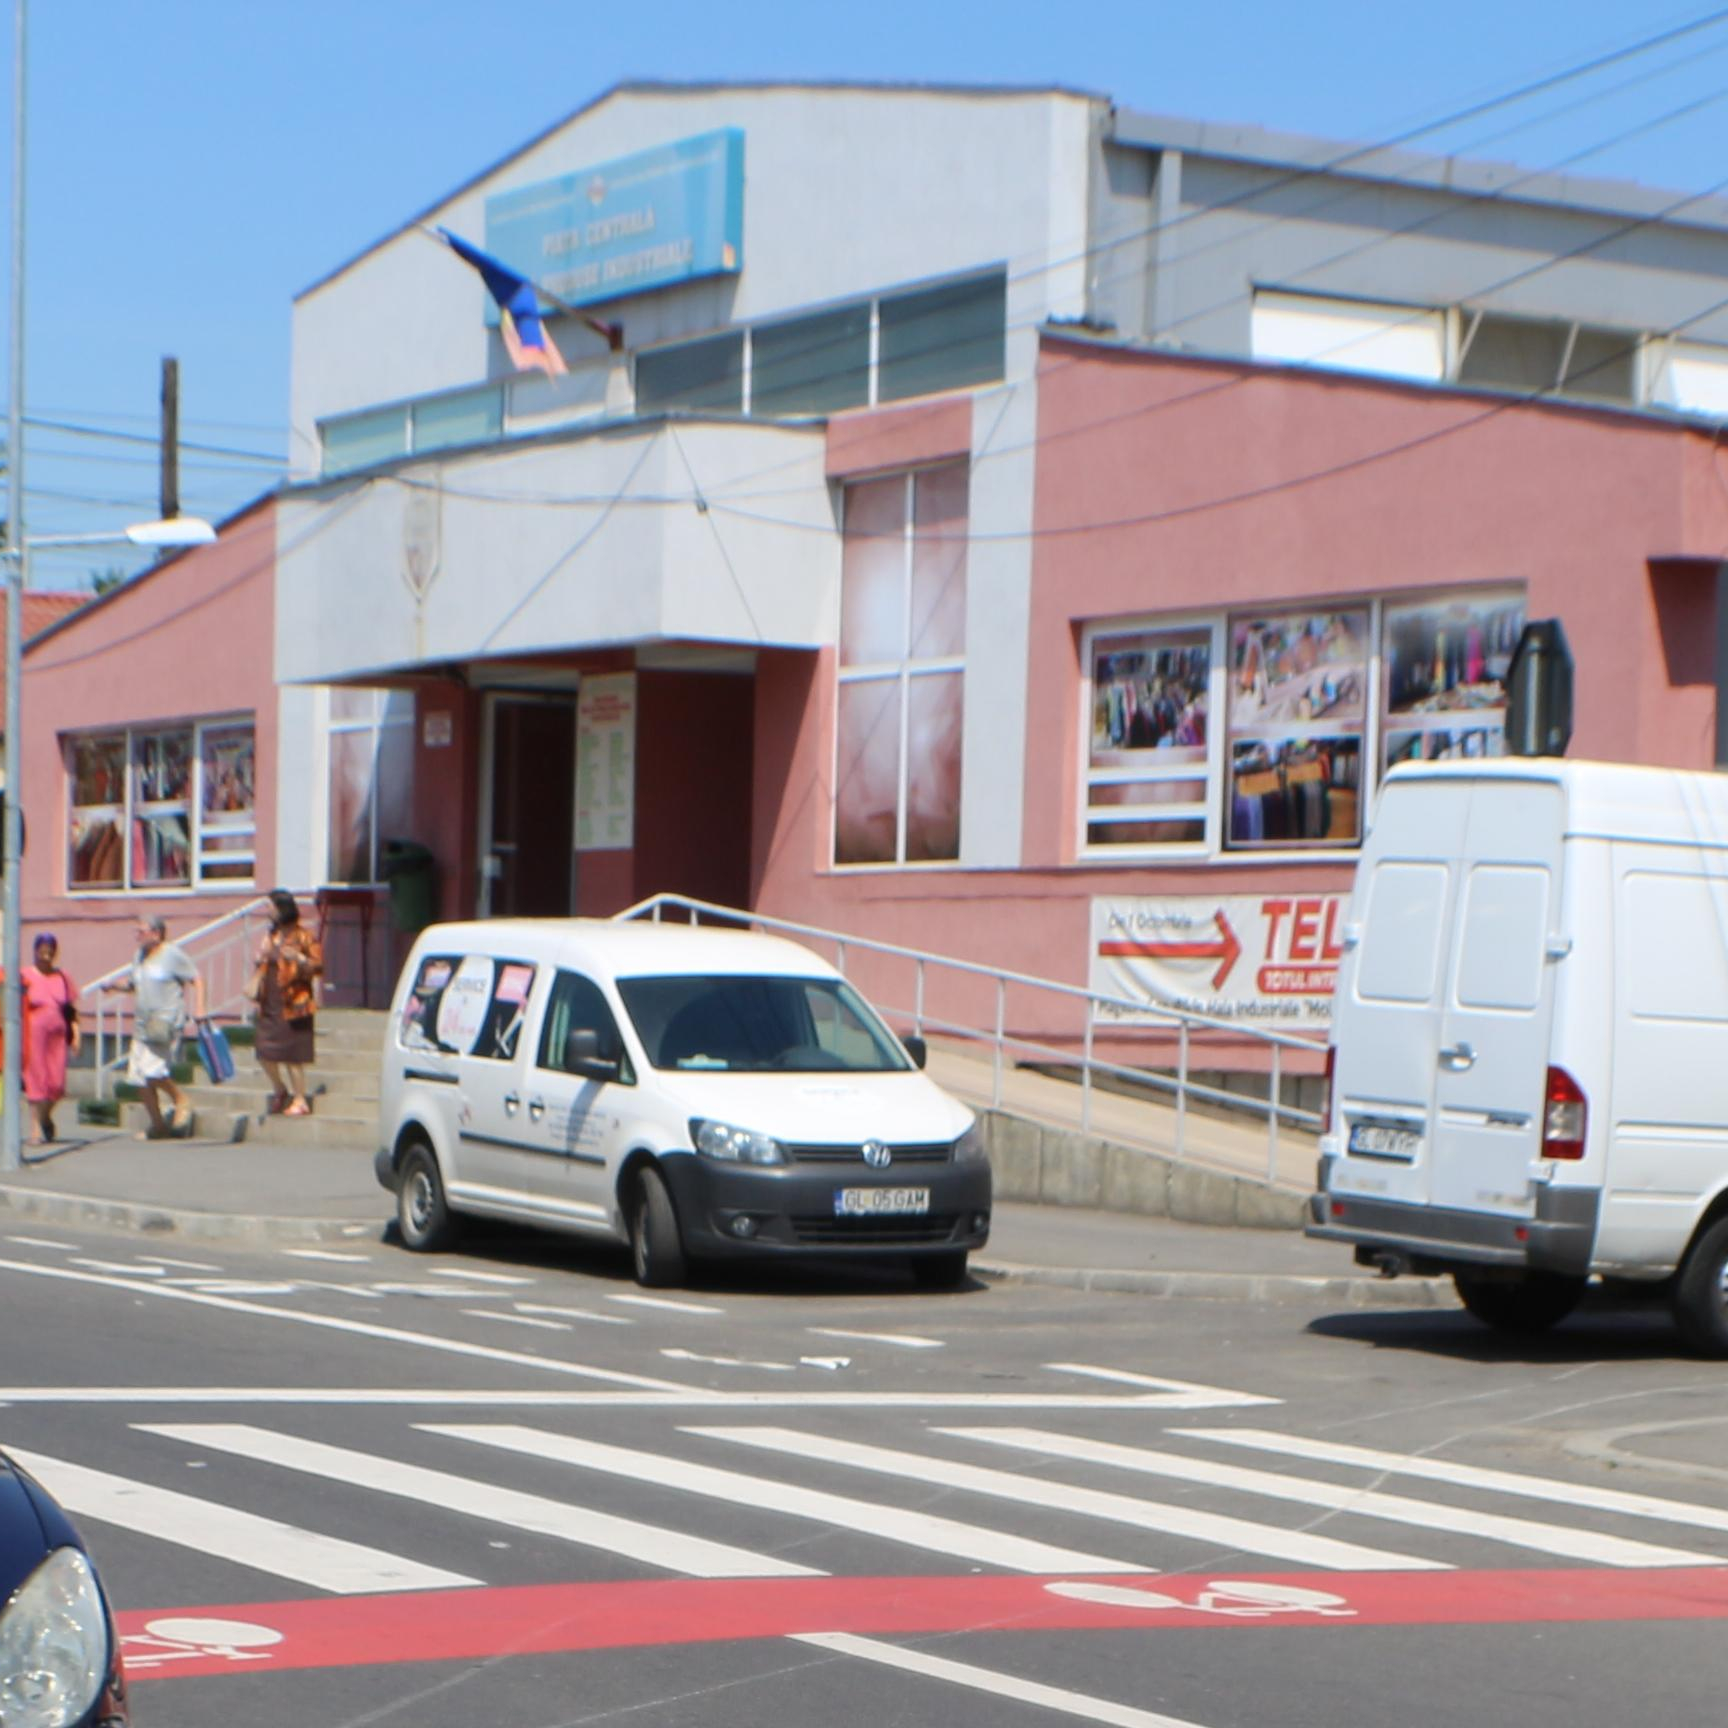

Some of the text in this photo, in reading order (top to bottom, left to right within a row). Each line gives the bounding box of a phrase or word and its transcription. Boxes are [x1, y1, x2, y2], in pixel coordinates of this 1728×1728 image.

[845, 1189, 925, 1209] GL 05 GAM
